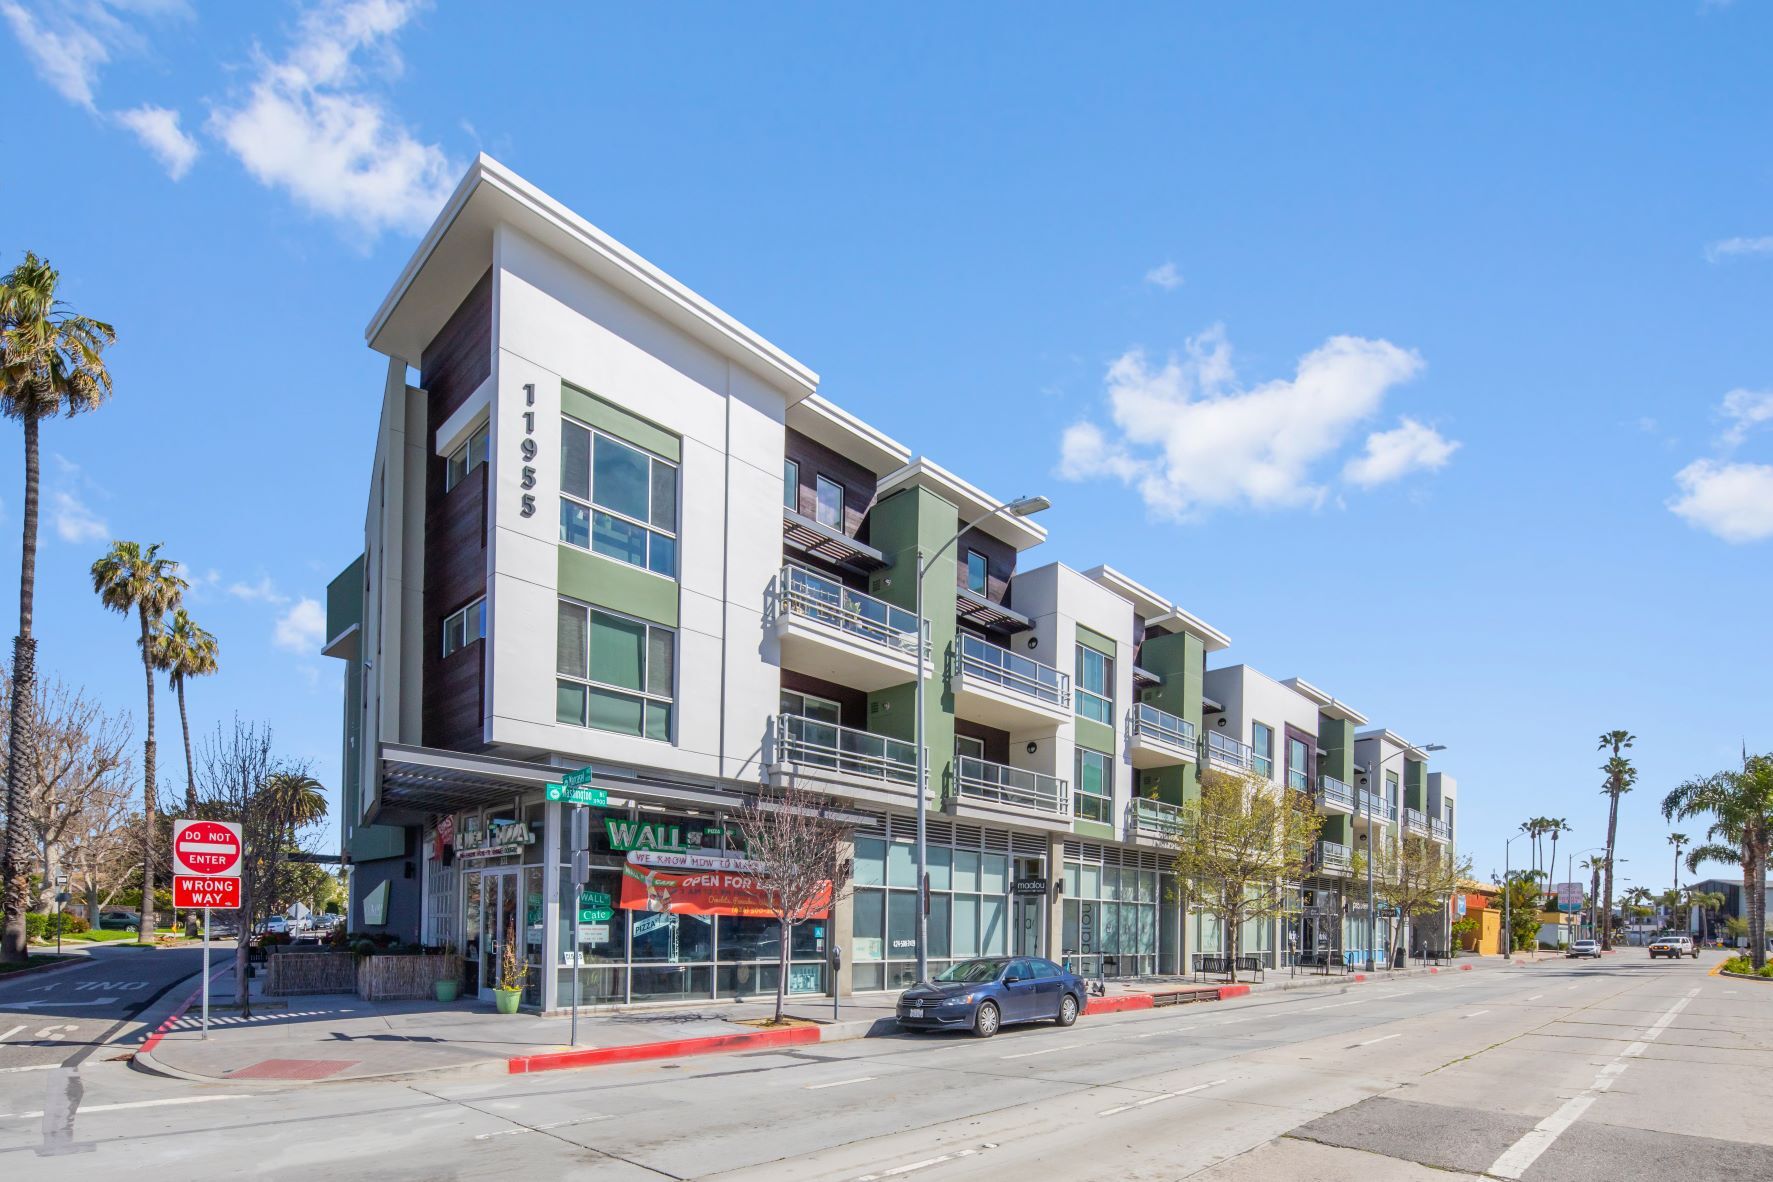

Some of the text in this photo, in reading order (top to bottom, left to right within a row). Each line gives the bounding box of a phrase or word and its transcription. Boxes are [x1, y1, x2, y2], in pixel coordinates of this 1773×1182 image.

[520, 383, 538, 519] 11955
[562, 785, 593, 802] Washington
[185, 831, 231, 841] DO NOT
[608, 821, 683, 851] WALL
[189, 855, 226, 864] ENTER
[636, 853, 651, 863] WE
[656, 855, 687, 866] KNOW
[691, 857, 714, 867] HOW
[720, 859, 730, 868] TO
[182, 880, 233, 892] WRONG
[682, 875, 719, 887] OPEN
[725, 876, 751, 889] FOR
[1018, 881, 1045, 889] maalou
[192, 893, 223, 904] WAY
[581, 893, 604, 903] WALL
[583, 911, 606, 920] Cafe
[636, 921, 656, 933] PIZZA
